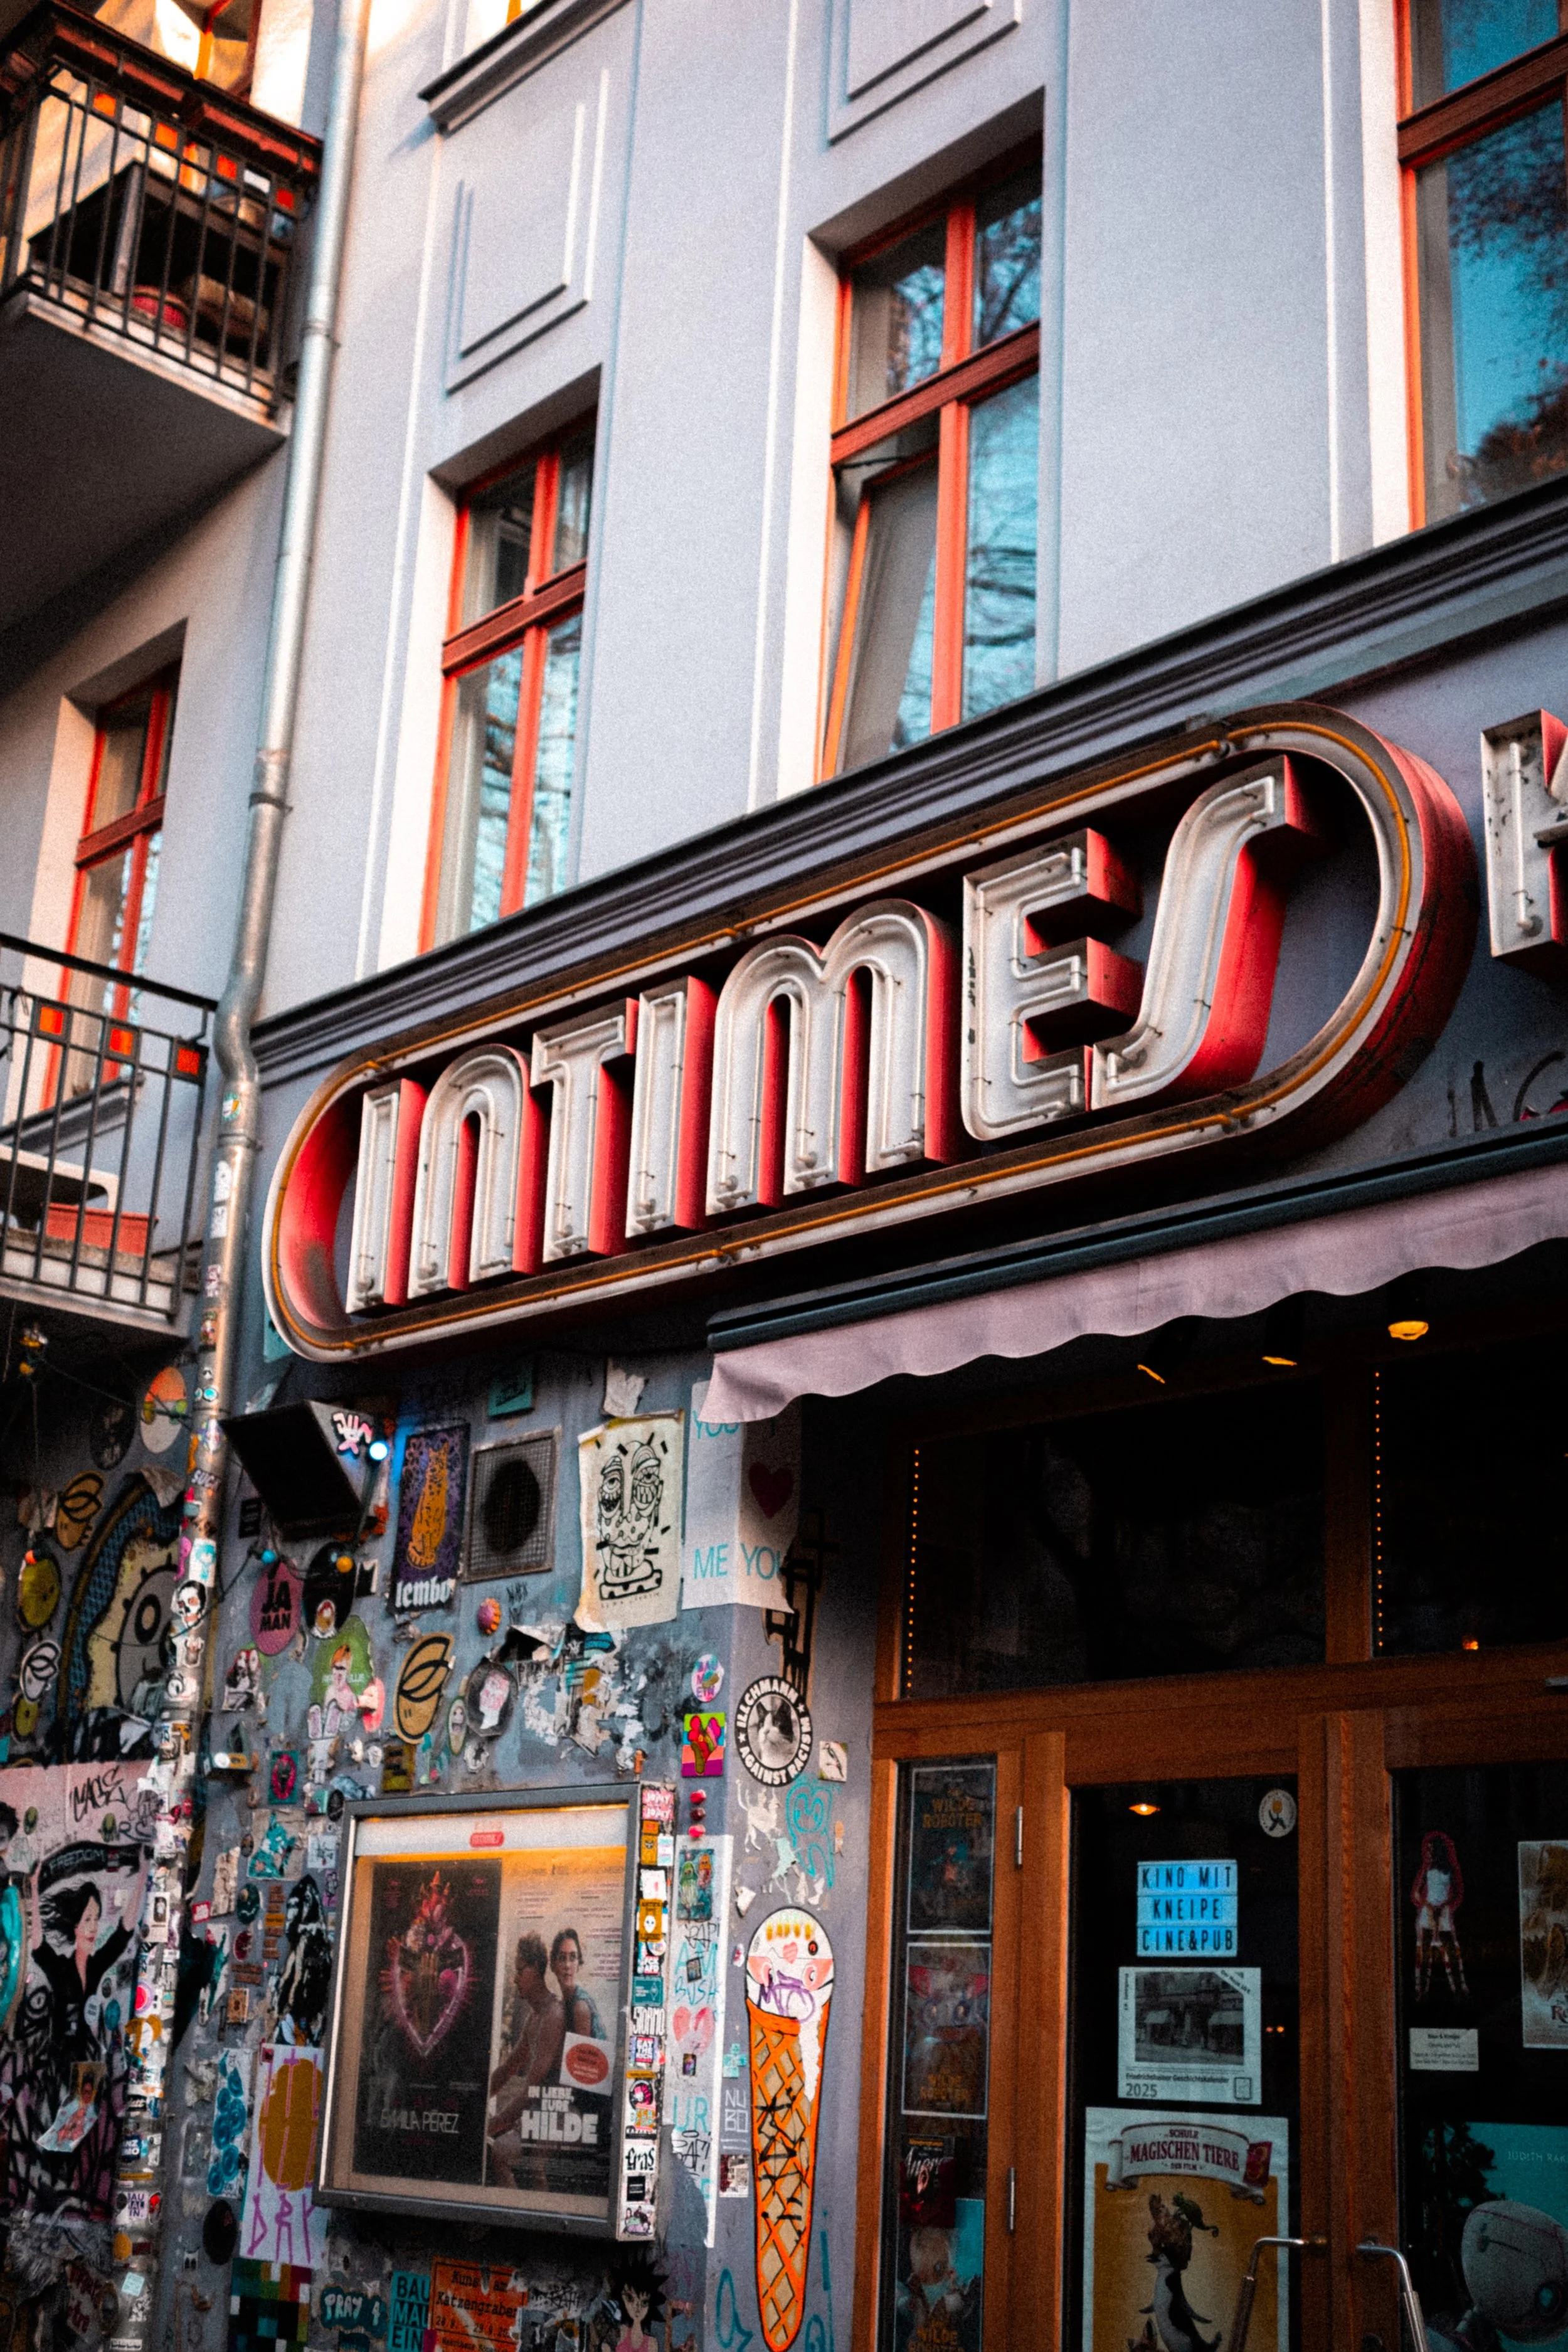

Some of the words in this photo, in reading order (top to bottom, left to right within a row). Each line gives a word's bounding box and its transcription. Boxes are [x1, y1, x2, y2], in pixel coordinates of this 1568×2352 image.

[693, 1543, 729, 1579] ME
[260, 1613, 292, 1631] MAN
[787, 1717, 811, 1779] RACISM
[739, 1745, 788, 1785] AGAINST
[1142, 1867, 1185, 1888] KINO
[1199, 1866, 1231, 1888] MIT
[1153, 1898, 1220, 1920] KNEIPE
[1142, 1930, 1233, 1952] CINE&PUB
[1126, 2083, 1157, 2098] 2025
[521, 2109, 598, 2144] HILDE
[1169, 2129, 1199, 2139] SCHULE
[1130, 2140, 1200, 2164] MAGISCHEN
[1202, 2143, 1240, 2171] TIERE
[396, 2275, 430, 2302] BAU
[324, 2293, 363, 2320] PRAY
[392, 2326, 423, 2352] EIN
